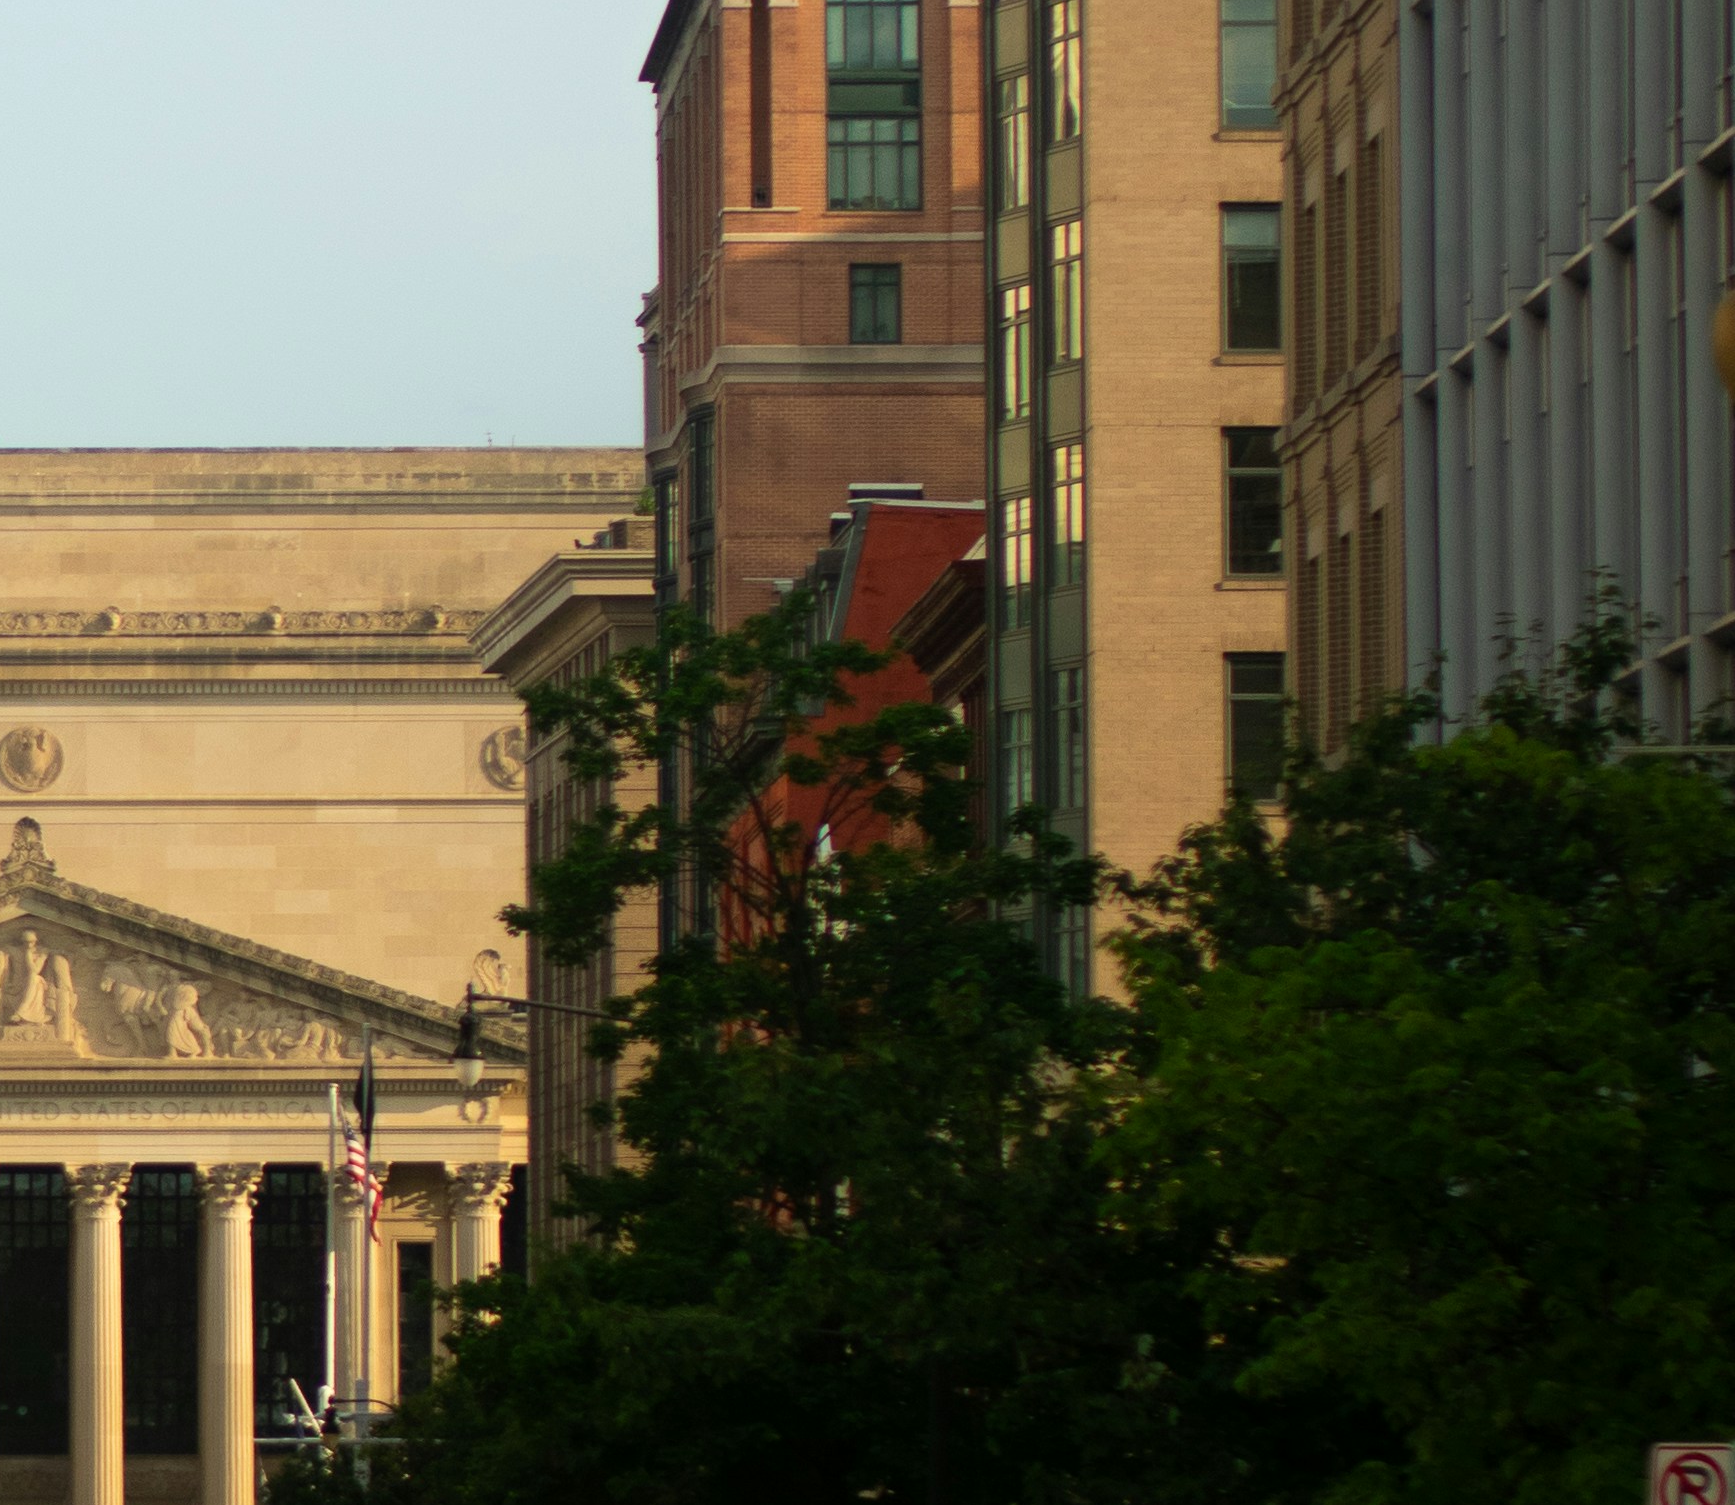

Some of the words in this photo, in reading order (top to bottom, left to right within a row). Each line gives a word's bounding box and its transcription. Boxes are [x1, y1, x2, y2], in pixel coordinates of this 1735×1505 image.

[71, 1101, 153, 1121] STATES
[160, 1101, 192, 1121] OF
[198, 1101, 316, 1121] AMERICA
